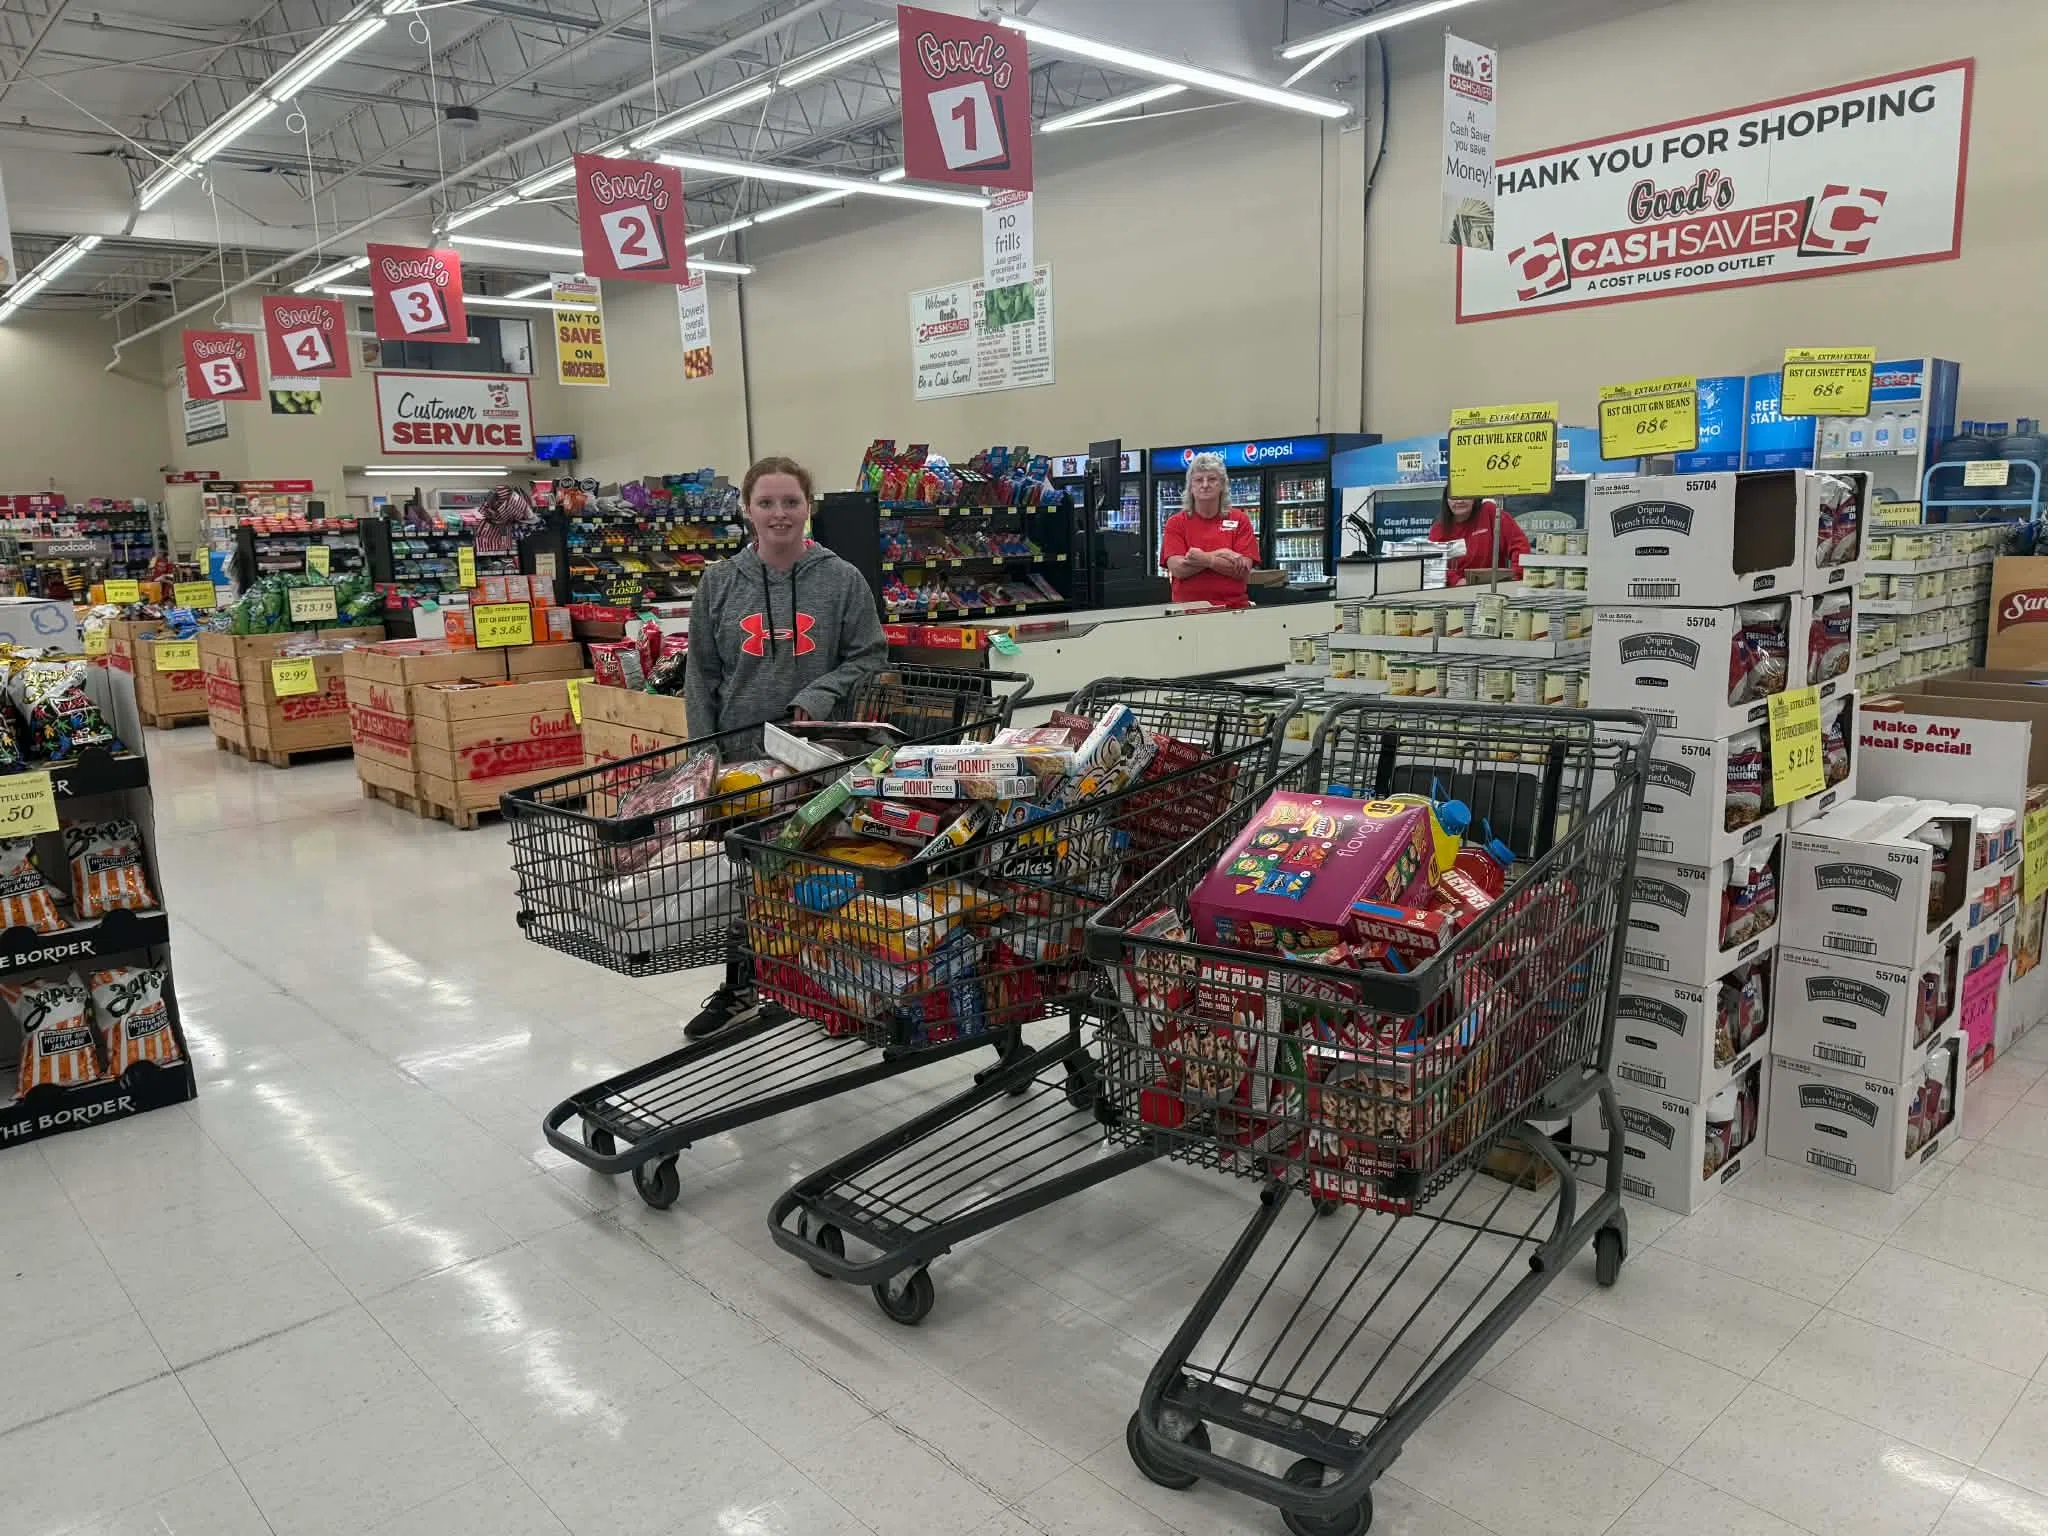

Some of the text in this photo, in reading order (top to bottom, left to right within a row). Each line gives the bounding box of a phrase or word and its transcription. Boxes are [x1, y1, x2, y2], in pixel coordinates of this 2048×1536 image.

[916, 32, 1013, 90] Good's
[1450, 77, 1492, 100] CASHSAVER
[951, 97, 977, 150] 1
[1450, 121, 1491, 144] Cash Saver
[1455, 139, 1487, 157] you save
[1495, 84, 1937, 197] HANK YOU FOR SHOPPING
[1446, 155, 1492, 188] Money!
[590, 170, 670, 211] Good's
[1627, 167, 1736, 224] Good's
[1000, 214, 1016, 230] no
[617, 216, 648, 257] 2
[995, 232, 1021, 254] frills
[1570, 208, 1799, 273] CASHSAVER
[381, 255, 450, 287] Good's
[1587, 254, 1775, 291] A COST PLUS FOOD OUTLET
[406, 291, 433, 323] 3
[274, 305, 334, 330] Good's
[557, 312, 600, 325] WAY TO
[560, 327, 602, 344] SAVE
[192, 338, 247, 360] Good's
[296, 335, 320, 361] 4
[575, 349, 593, 359] ON
[212, 364, 233, 387] 5
[562, 361, 605, 378] GROCERIES
[1788, 368, 1868, 378] BST CH SWEET PEAS
[397, 391, 477, 421] Customer
[1607, 398, 1691, 417] BST CH CUT GRN BEANS
[391, 421, 523, 446] SERVICE
[1636, 416, 1669, 434] 68¢
[1456, 430, 1548, 446] BST CH WHL KER CORN
[1259, 442, 1293, 459] pepsi
[1486, 451, 1523, 470] 68¢
[1686, 480, 1717, 491] 55704
[1383, 517, 1434, 527] Clearly Better
[1532, 520, 1573, 529] BIG BAG
[48, 543, 97, 554] goodcook
[606, 585, 642, 596] CLOSED
[612, 579, 638, 587] LANE
[1686, 616, 1717, 628] 55704
[1872, 719, 1961, 739] Make Any
[1681, 745, 1711, 757] 55704
[1859, 735, 1972, 756] Meal Special!
[933, 763, 957, 772] Glazed
[957, 759, 991, 773] DONUT
[1728, 772, 1759, 780] ONIONS
[20, 791, 45, 799] CHIPS
[884, 783, 904, 793] Glazed
[903, 781, 932, 795] DONUT
[1336, 818, 1376, 857] flavor
[1887, 852, 1919, 865] 55704
[1003, 859, 1053, 878] Cakes
[1677, 867, 1706, 880] 55704
[1441, 869, 1496, 911] HELPER
[1356, 918, 1437, 949] HELPER
[15, 940, 97, 966] BORDER
[1875, 970, 1907, 984] 55704
[1674, 988, 1703, 1004] 55704
[1865, 1080, 1895, 1097] 55704
[38, 1096, 136, 1131] BORDER
[1662, 1100, 1690, 1117] 55704
